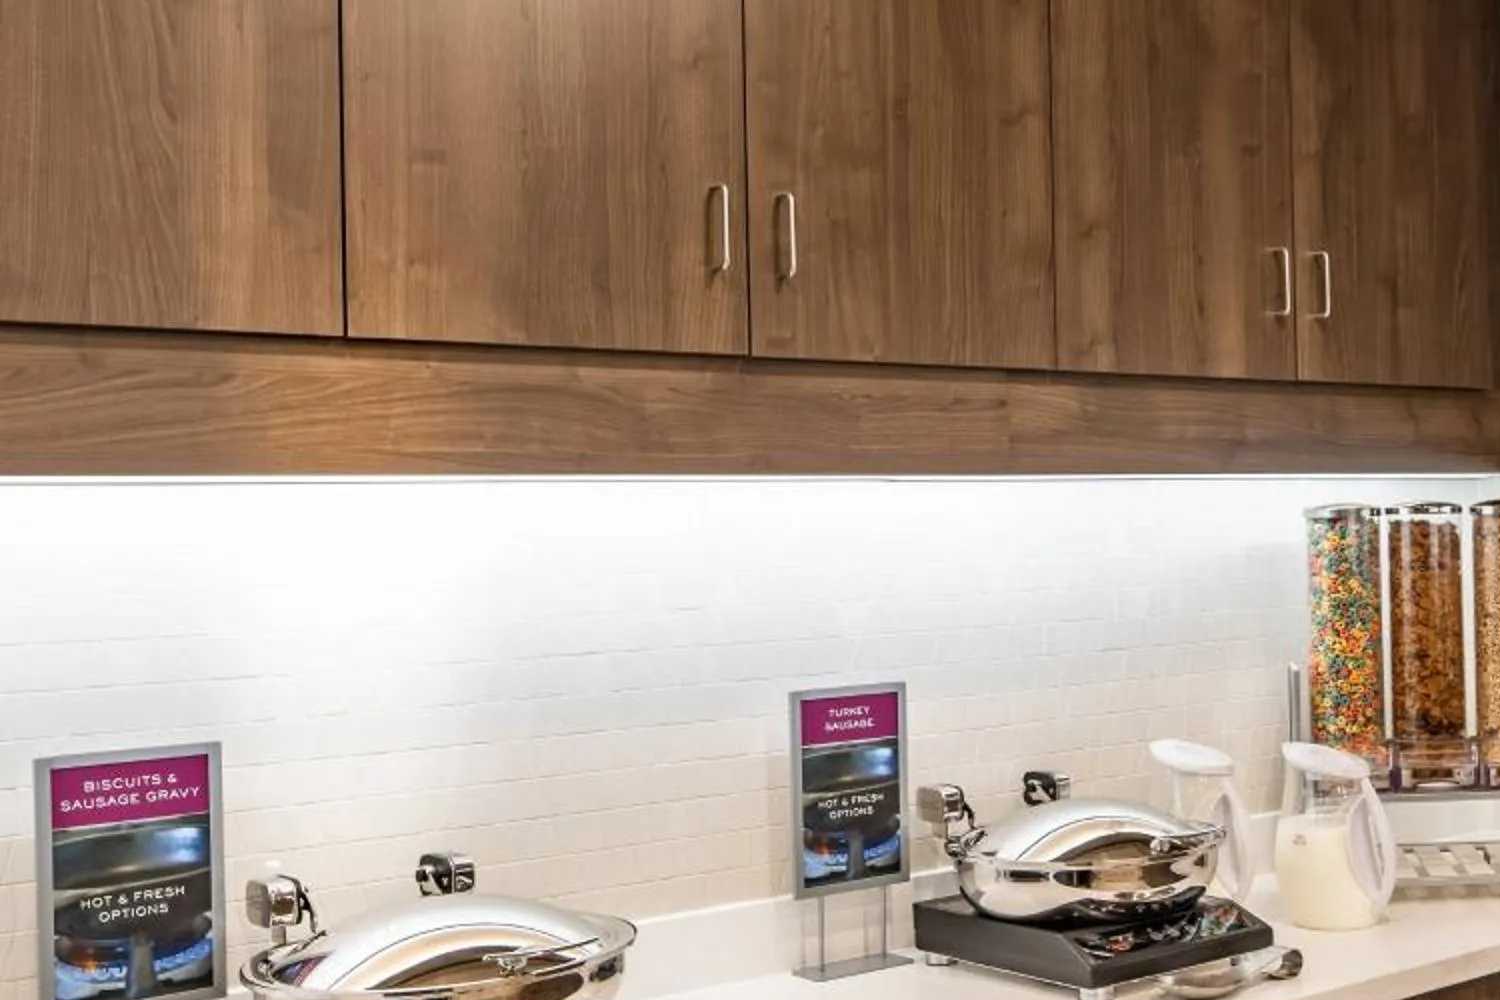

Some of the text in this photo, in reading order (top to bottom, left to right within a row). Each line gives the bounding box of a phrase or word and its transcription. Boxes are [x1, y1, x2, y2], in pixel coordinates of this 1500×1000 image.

[829, 706, 870, 718] TURKEY
[825, 717, 875, 731] SAUSAGE
[83, 773, 178, 793] BISCUITS &
[60, 786, 200, 812] SAUSAGE GRAVY
[818, 798, 838, 809] HOT
[851, 793, 885, 804] FRESH
[829, 805, 874, 819] OPTIONS
[80, 885, 186, 911] HOT & FRESH
[98, 903, 170, 923] OPTIONS
